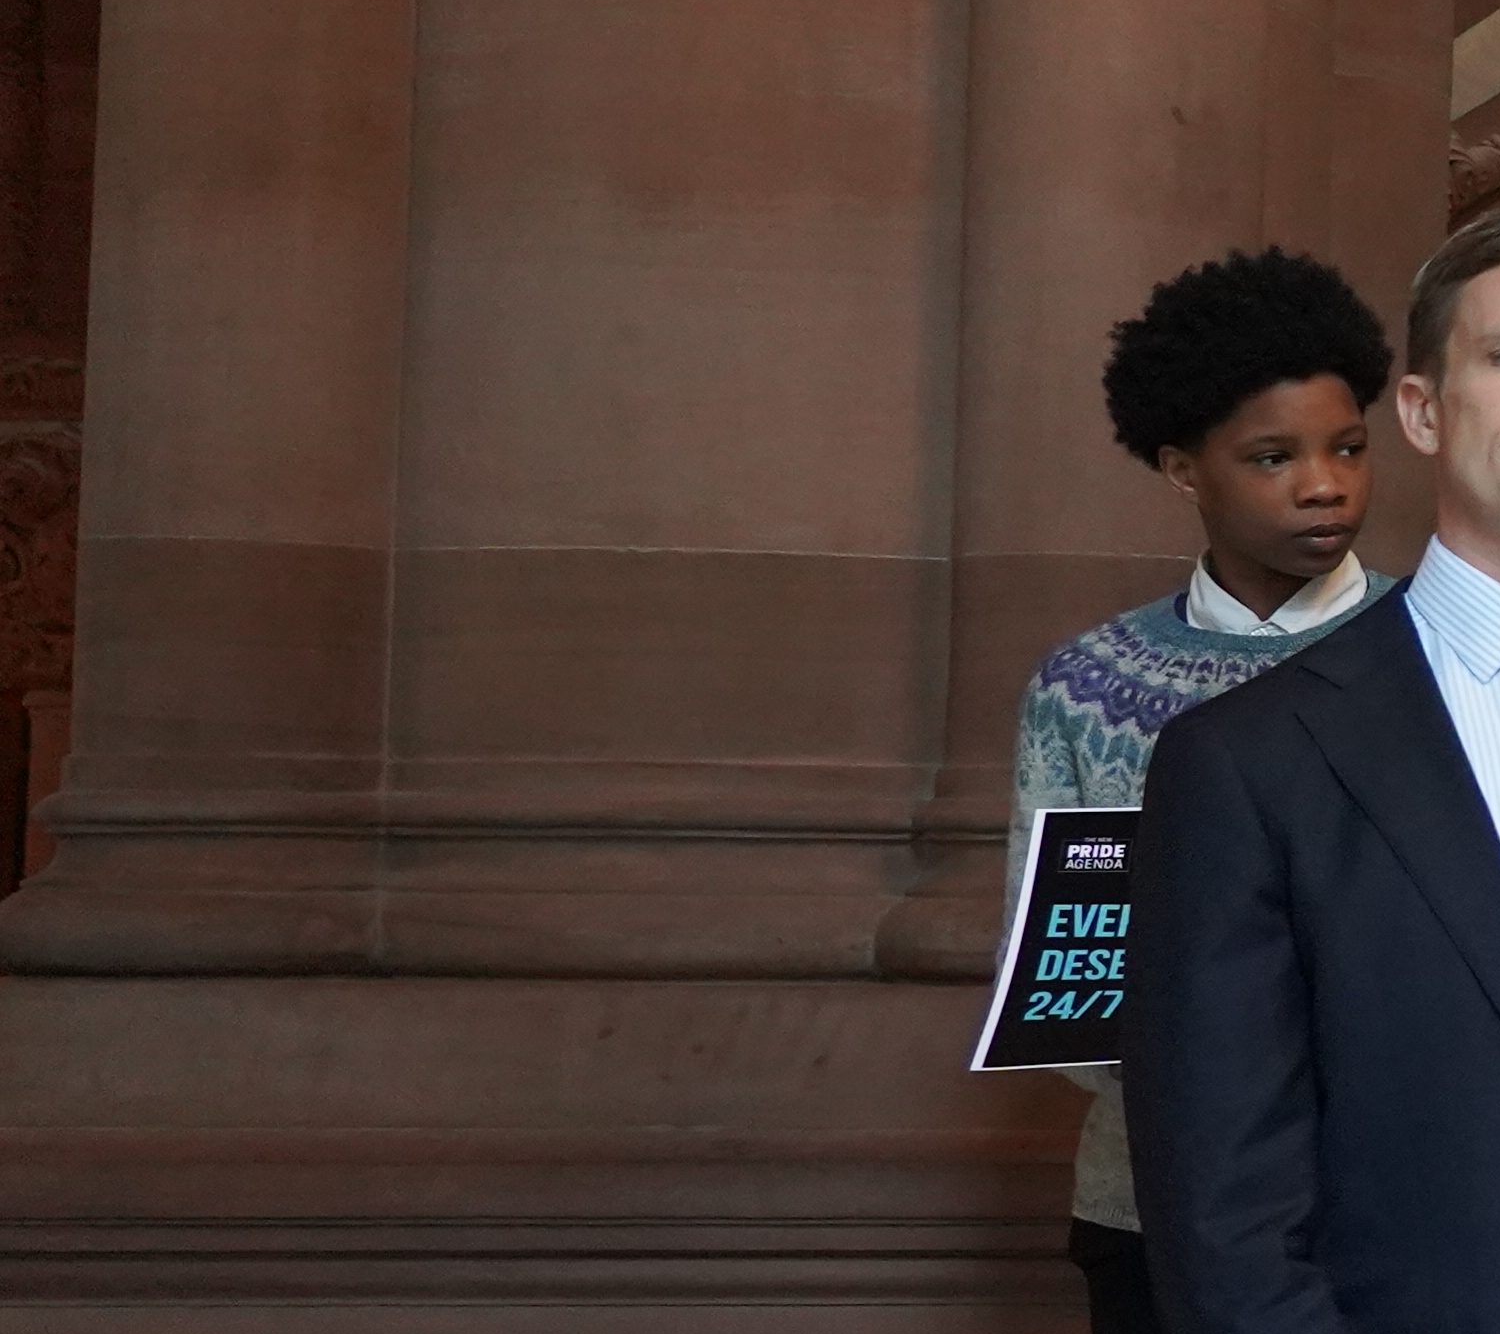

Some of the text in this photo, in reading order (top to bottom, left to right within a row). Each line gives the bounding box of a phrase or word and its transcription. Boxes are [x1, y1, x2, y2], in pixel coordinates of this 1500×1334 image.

[1067, 845, 1126, 857] PRIDE
[1065, 859, 1123, 869] AGENDA
[1023, 990, 1123, 1021] 24/7
